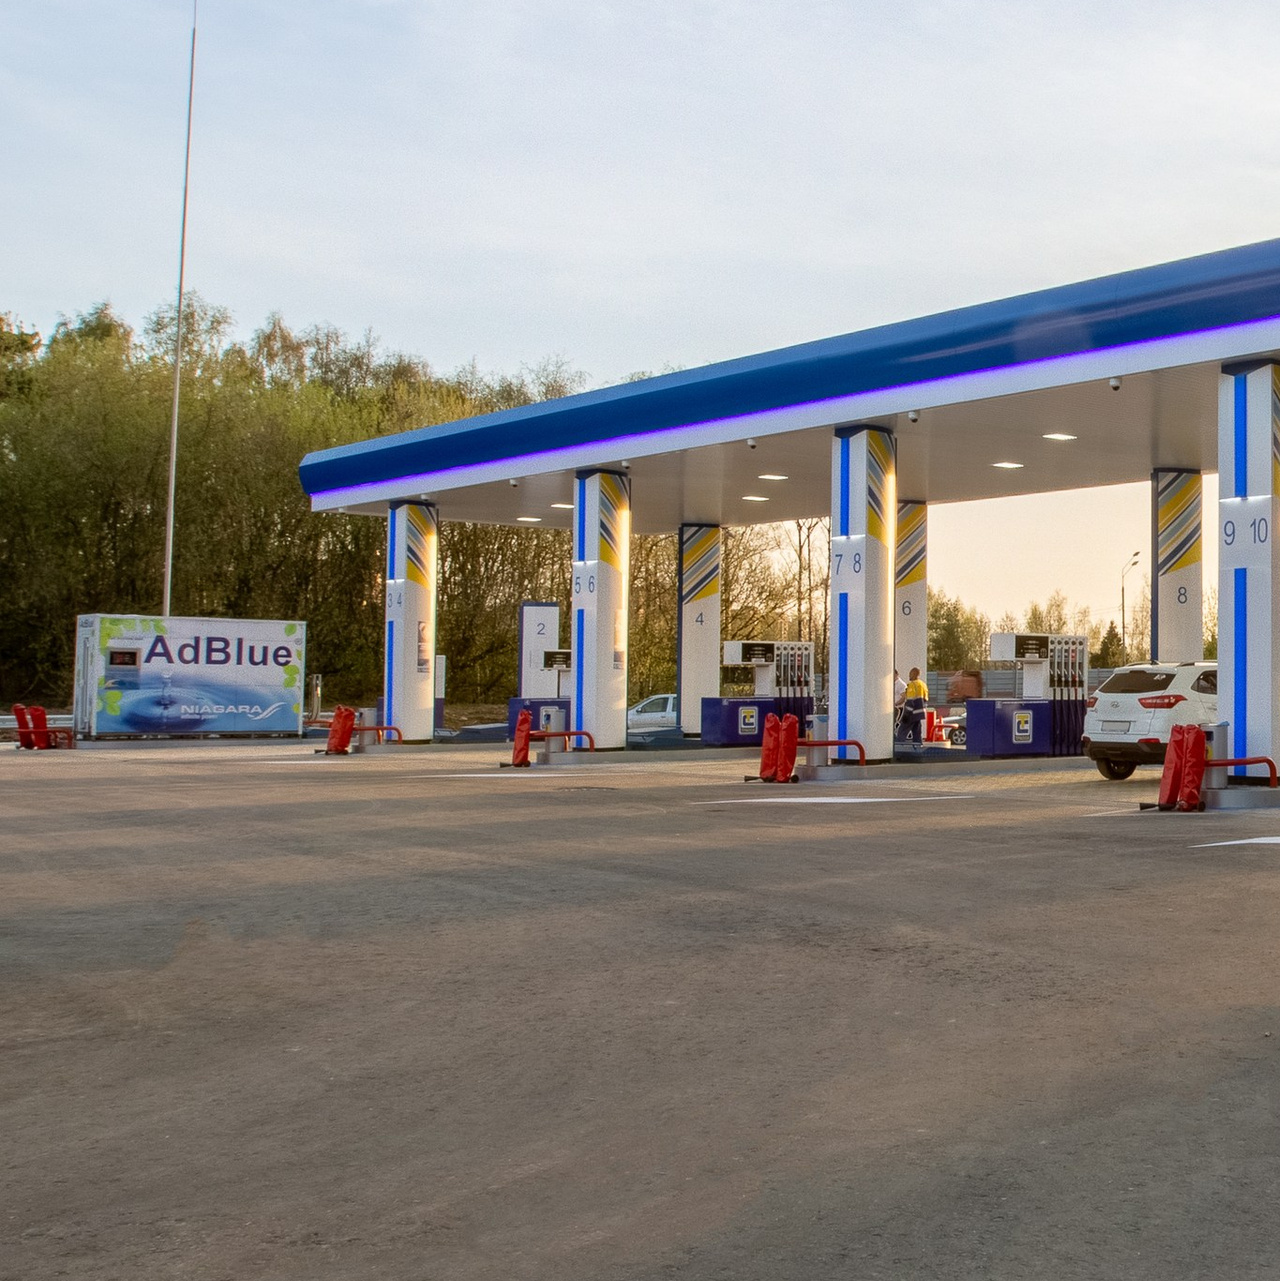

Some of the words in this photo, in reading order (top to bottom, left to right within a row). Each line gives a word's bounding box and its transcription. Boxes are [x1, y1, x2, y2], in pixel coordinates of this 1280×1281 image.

[1223, 520, 1236, 546] 9
[1249, 517, 1269, 544] 10
[835, 553, 844, 576] 7
[853, 552, 862, 574] 8
[574, 576, 582, 594] 5
[588, 575, 595, 593] 6
[387, 592, 394, 609] 3
[396, 592, 403, 608] 4
[1177, 586, 1188, 604] 8
[901, 600, 912, 616] 6
[695, 612, 705, 626] 4
[536, 622, 546, 636] 2
[144, 635, 293, 667] AdBlue
[180, 704, 263, 714] NIAGARA
